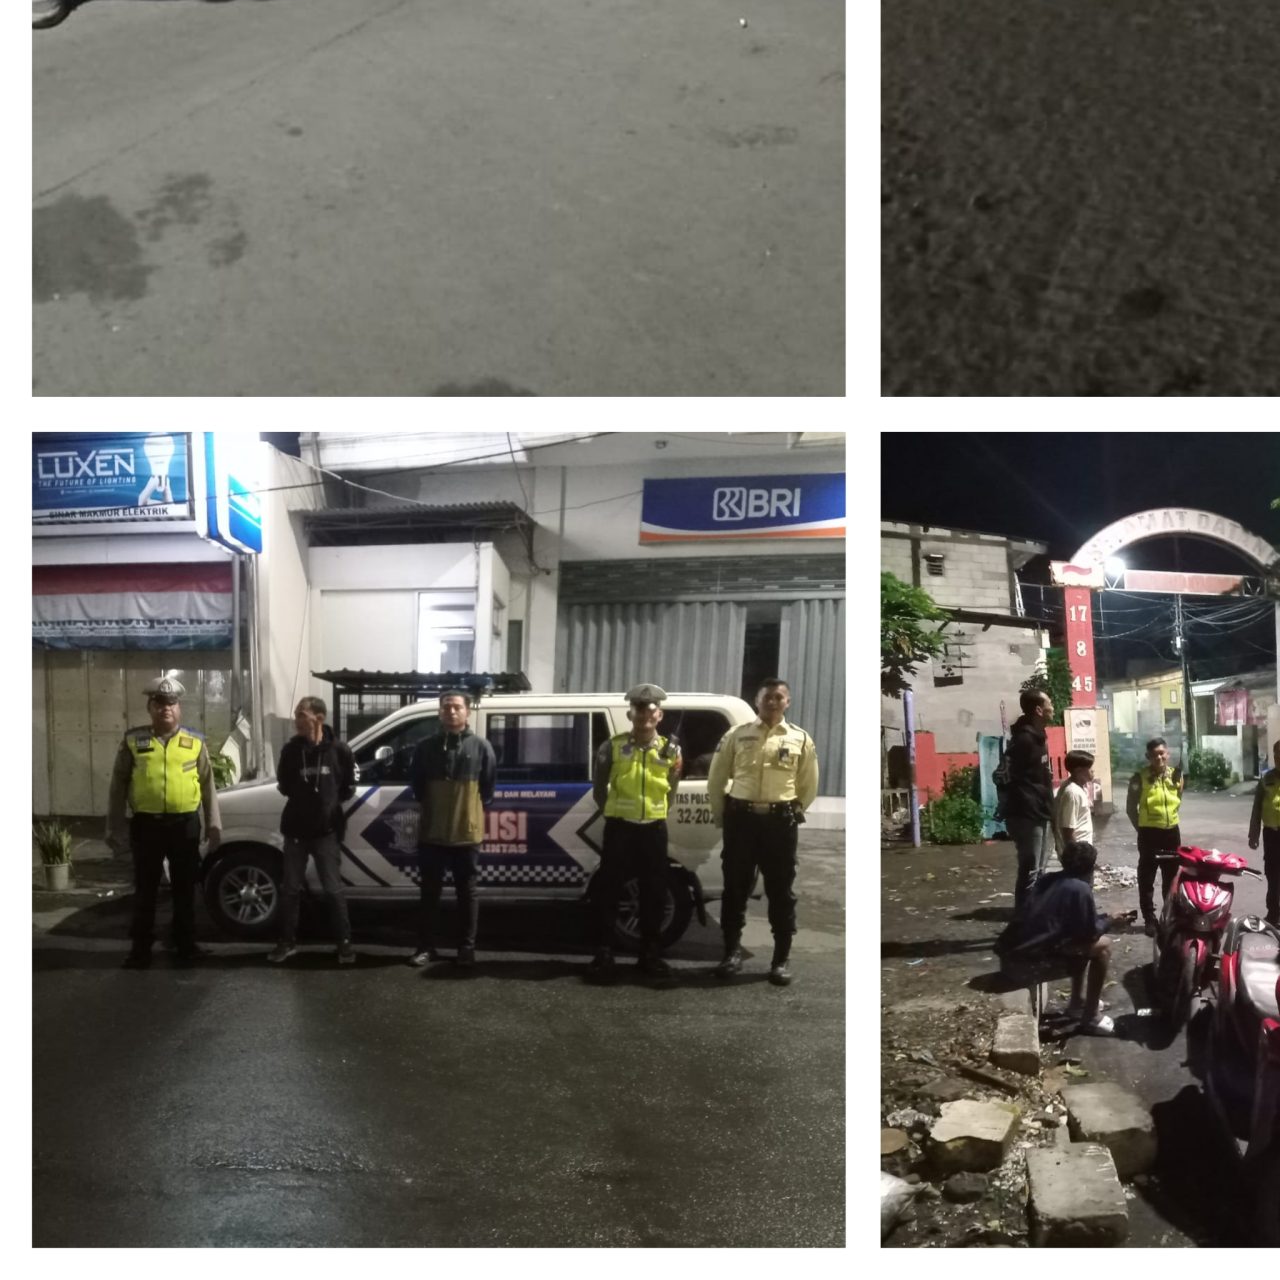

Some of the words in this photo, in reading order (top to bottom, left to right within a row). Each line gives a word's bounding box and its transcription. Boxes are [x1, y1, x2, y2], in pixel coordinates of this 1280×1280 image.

[37, 448, 135, 479] LUXEN
[54, 478, 83, 487] FUTURE
[86, 478, 97, 486] OF
[99, 476, 137, 485] LIGHTING
[747, 487, 802, 518] BRI
[49, 511, 78, 519] SINAR
[80, 508, 120, 518] MAKMUR
[122, 507, 169, 517] ELEKTRIK
[1069, 605, 1088, 622] 17
[1076, 640, 1087, 657] 8
[1071, 675, 1093, 692] 45
[690, 793, 710, 805] POLS
[484, 811, 528, 841] LISI
